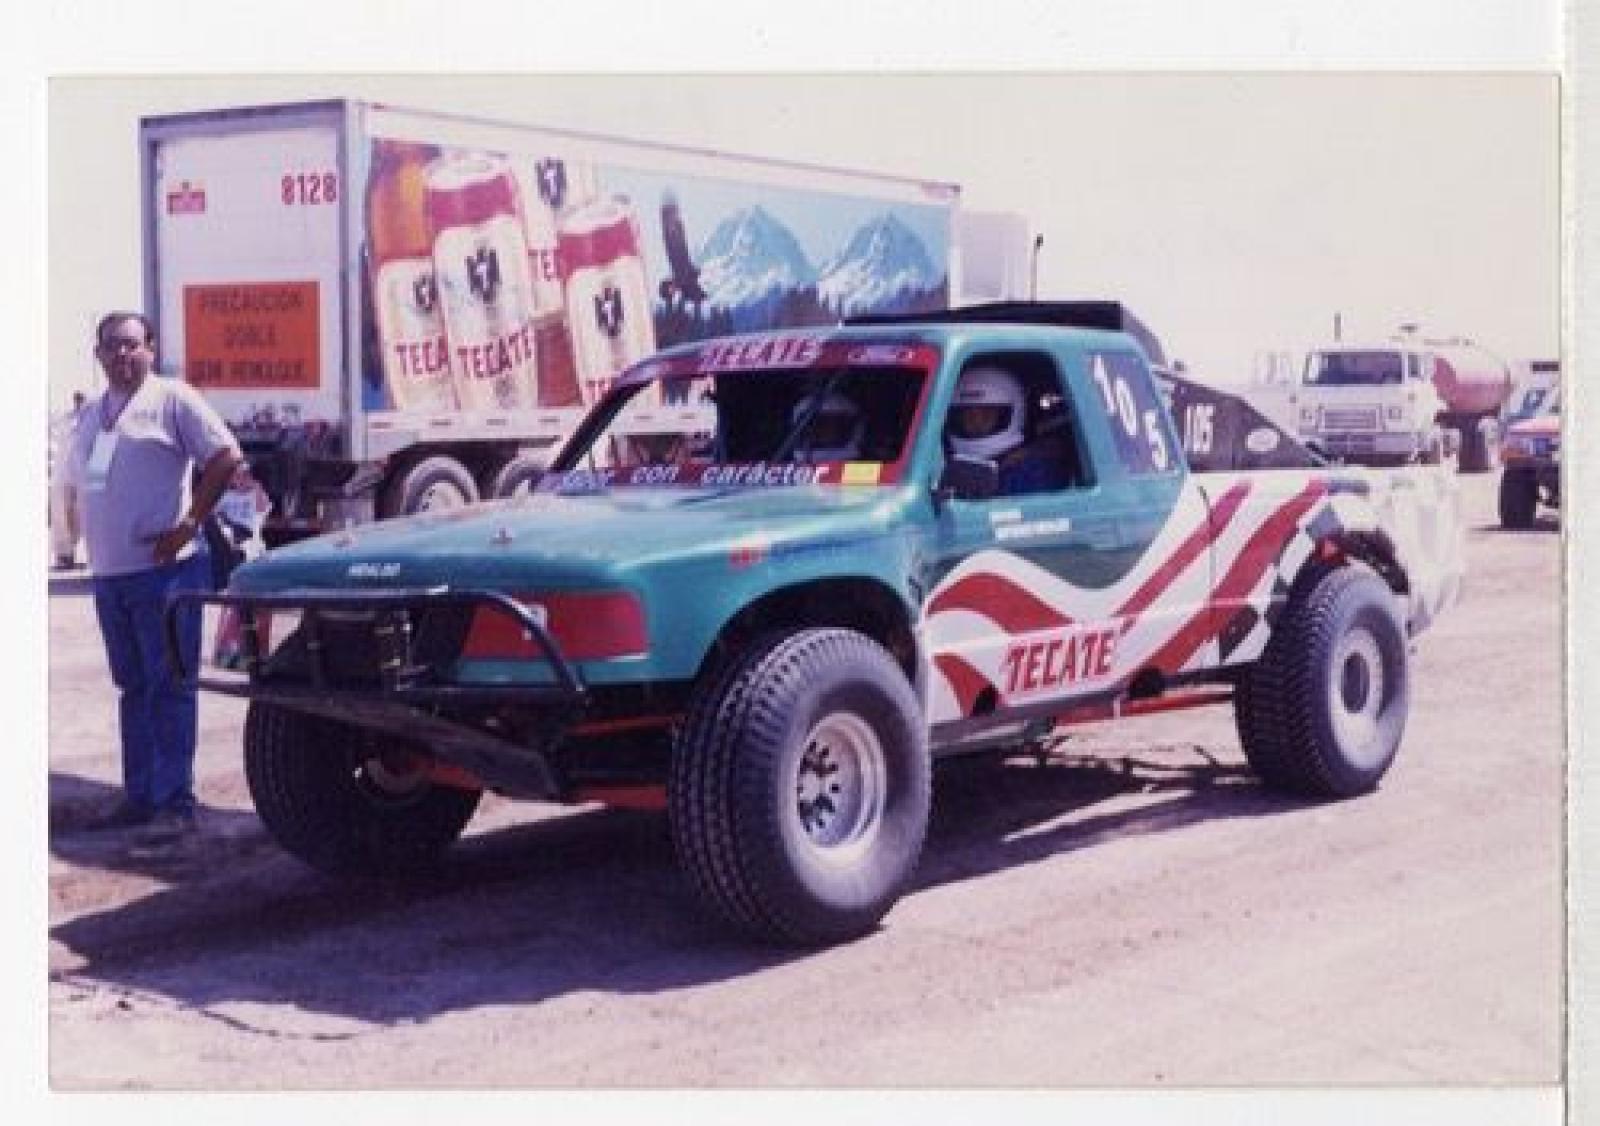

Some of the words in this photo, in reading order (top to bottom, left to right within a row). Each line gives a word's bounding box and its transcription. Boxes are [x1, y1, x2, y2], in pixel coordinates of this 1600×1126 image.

[280, 173, 337, 206] 8128
[456, 323, 533, 379] TECATE
[700, 336, 820, 369] TECATE
[1089, 354, 1169, 471] 105
[632, 464, 679, 485] con
[1004, 628, 1116, 693] TECATE
